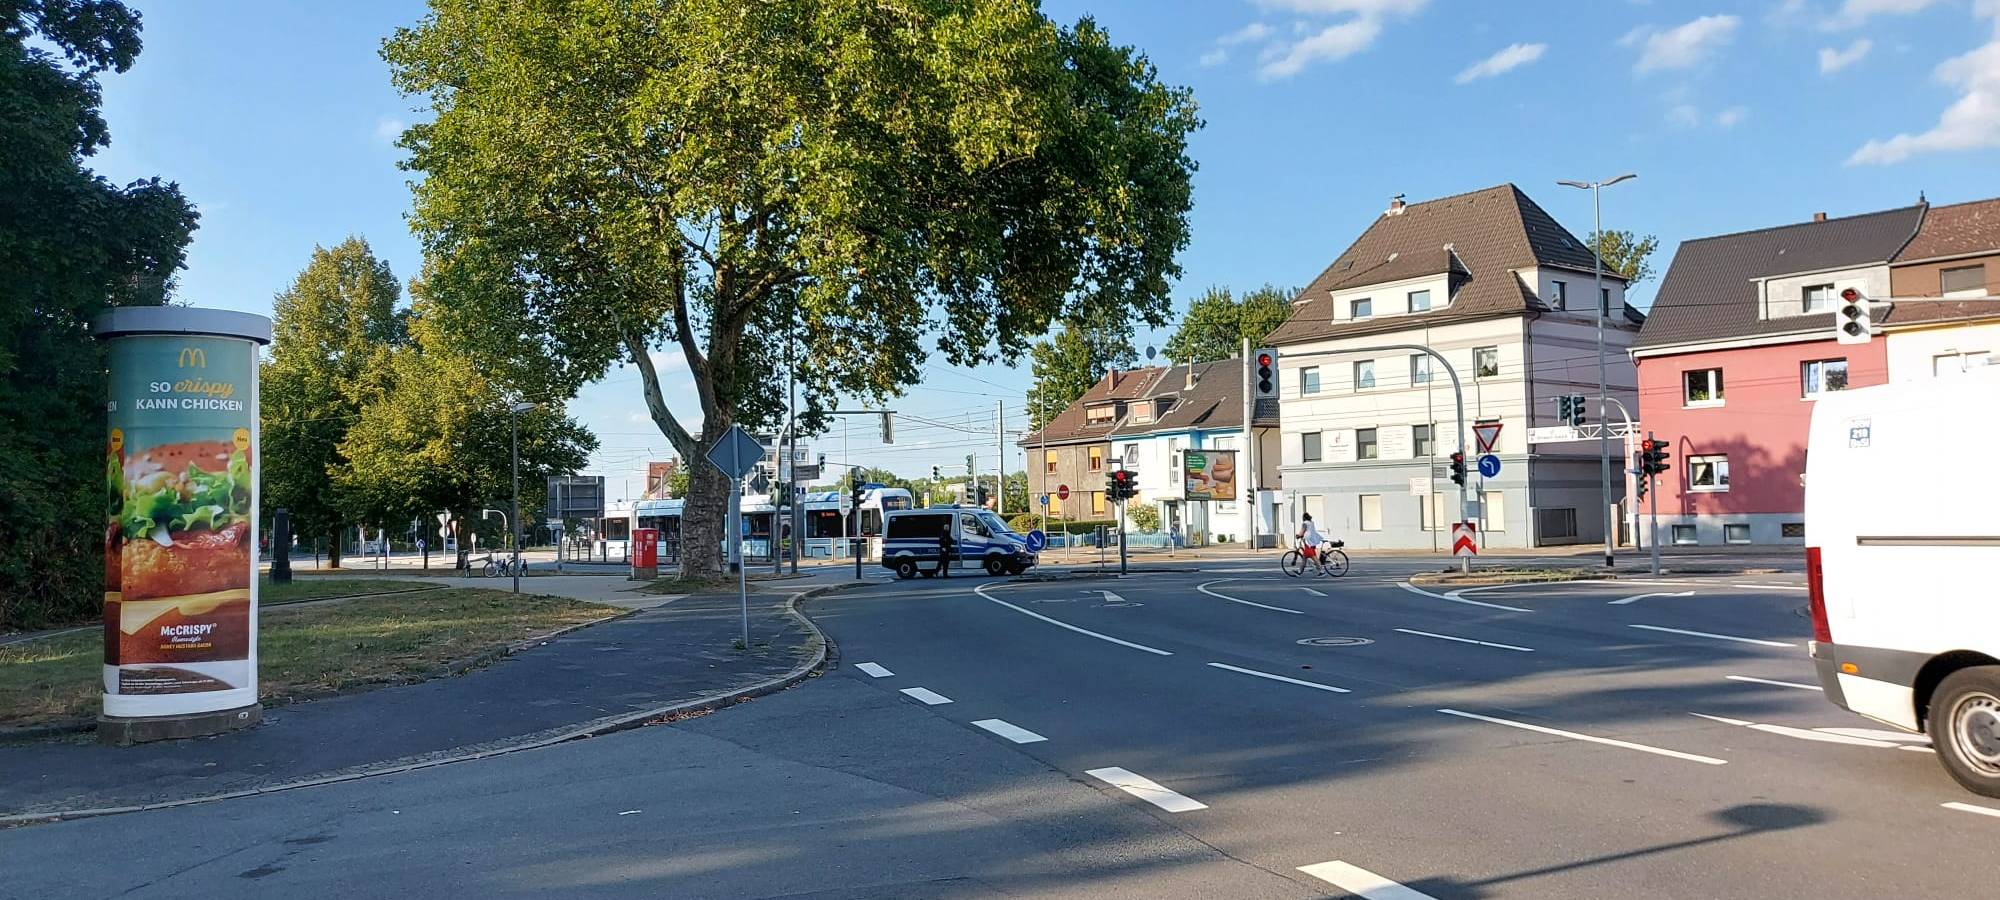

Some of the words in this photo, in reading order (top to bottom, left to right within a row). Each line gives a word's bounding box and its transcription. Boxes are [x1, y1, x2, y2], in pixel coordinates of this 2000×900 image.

[150, 381, 171, 393] SO
[174, 377, 234, 398] crispy
[136, 398, 178, 410] KANN
[181, 398, 243, 411] CHICKEN
